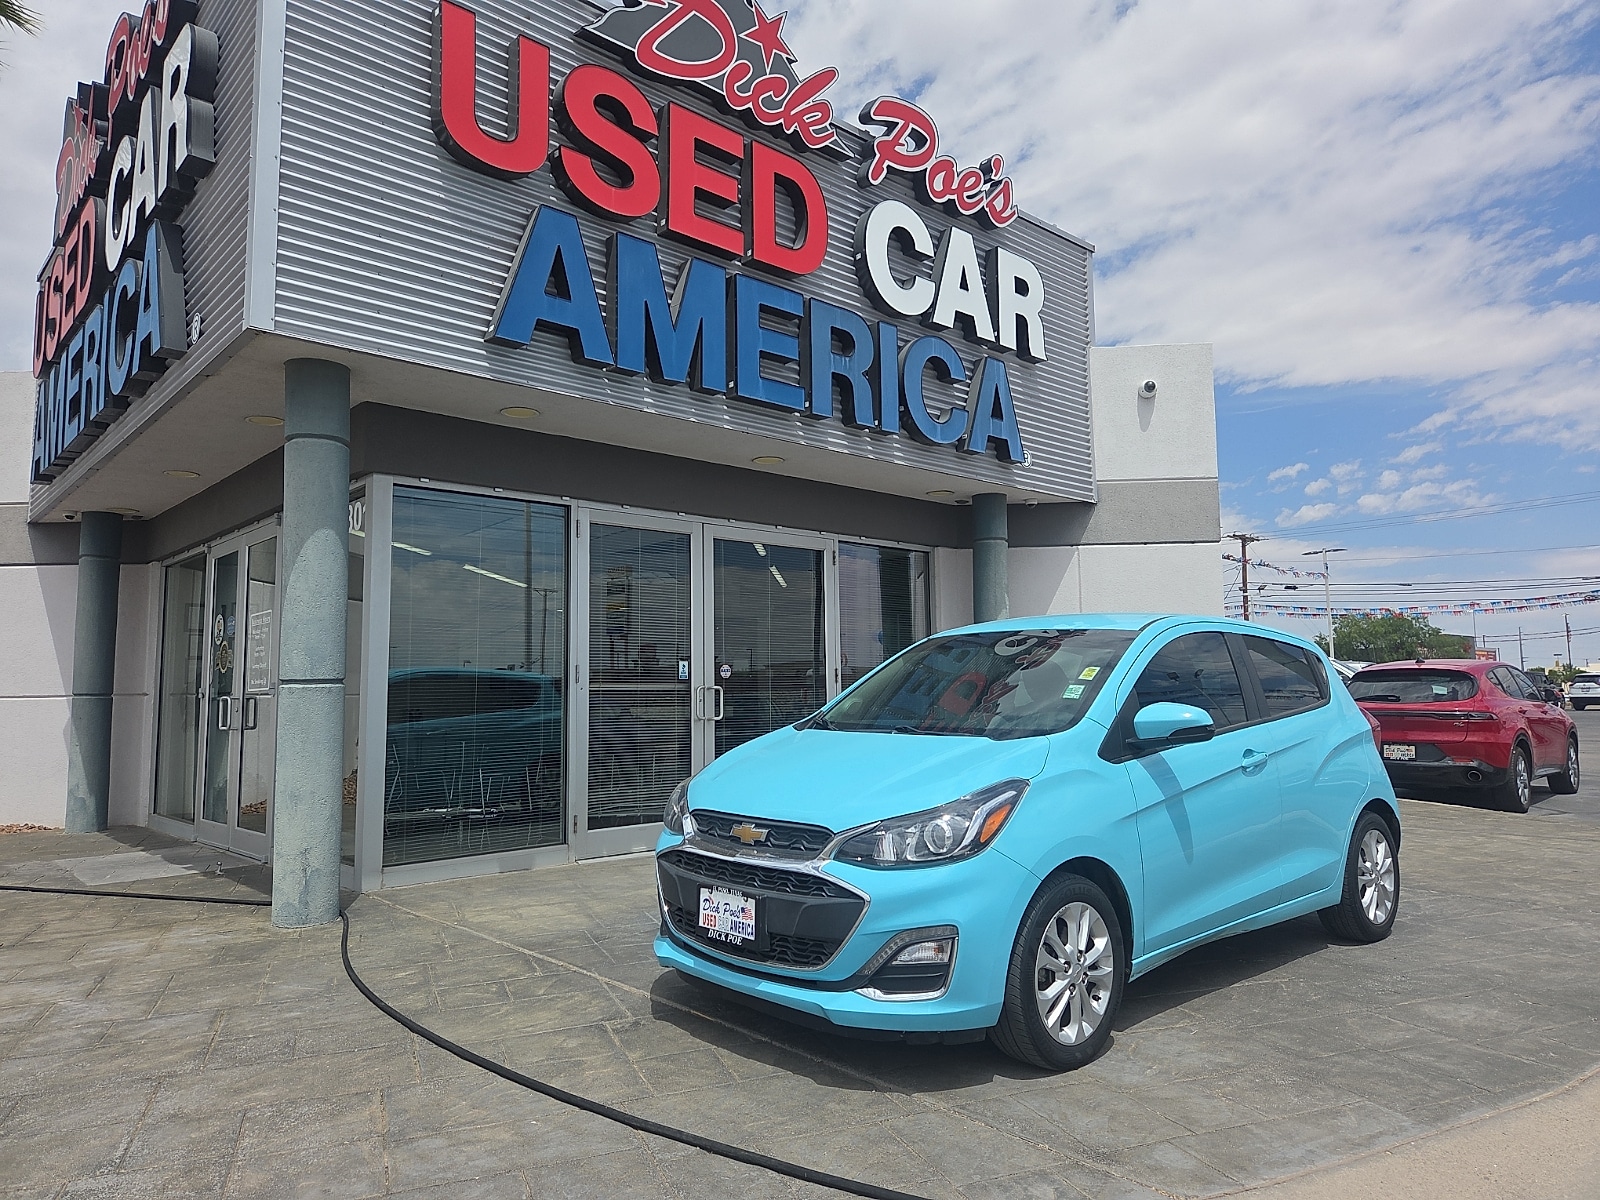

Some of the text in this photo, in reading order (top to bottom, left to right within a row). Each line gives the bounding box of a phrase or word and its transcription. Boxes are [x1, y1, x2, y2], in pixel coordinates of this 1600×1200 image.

[33, 22, 191, 379] USED CAR
[436, 0, 1048, 363] USED CAR
[634, 0, 1018, 229] Dick Poe's
[32, 219, 161, 483] AMERICA
[488, 204, 1025, 465] AMERICA
[703, 898, 741, 918] Dick Poe's
[703, 913, 716, 927] USED
[729, 918, 755, 938] AMERICA
[708, 929, 743, 945] DICK POE
